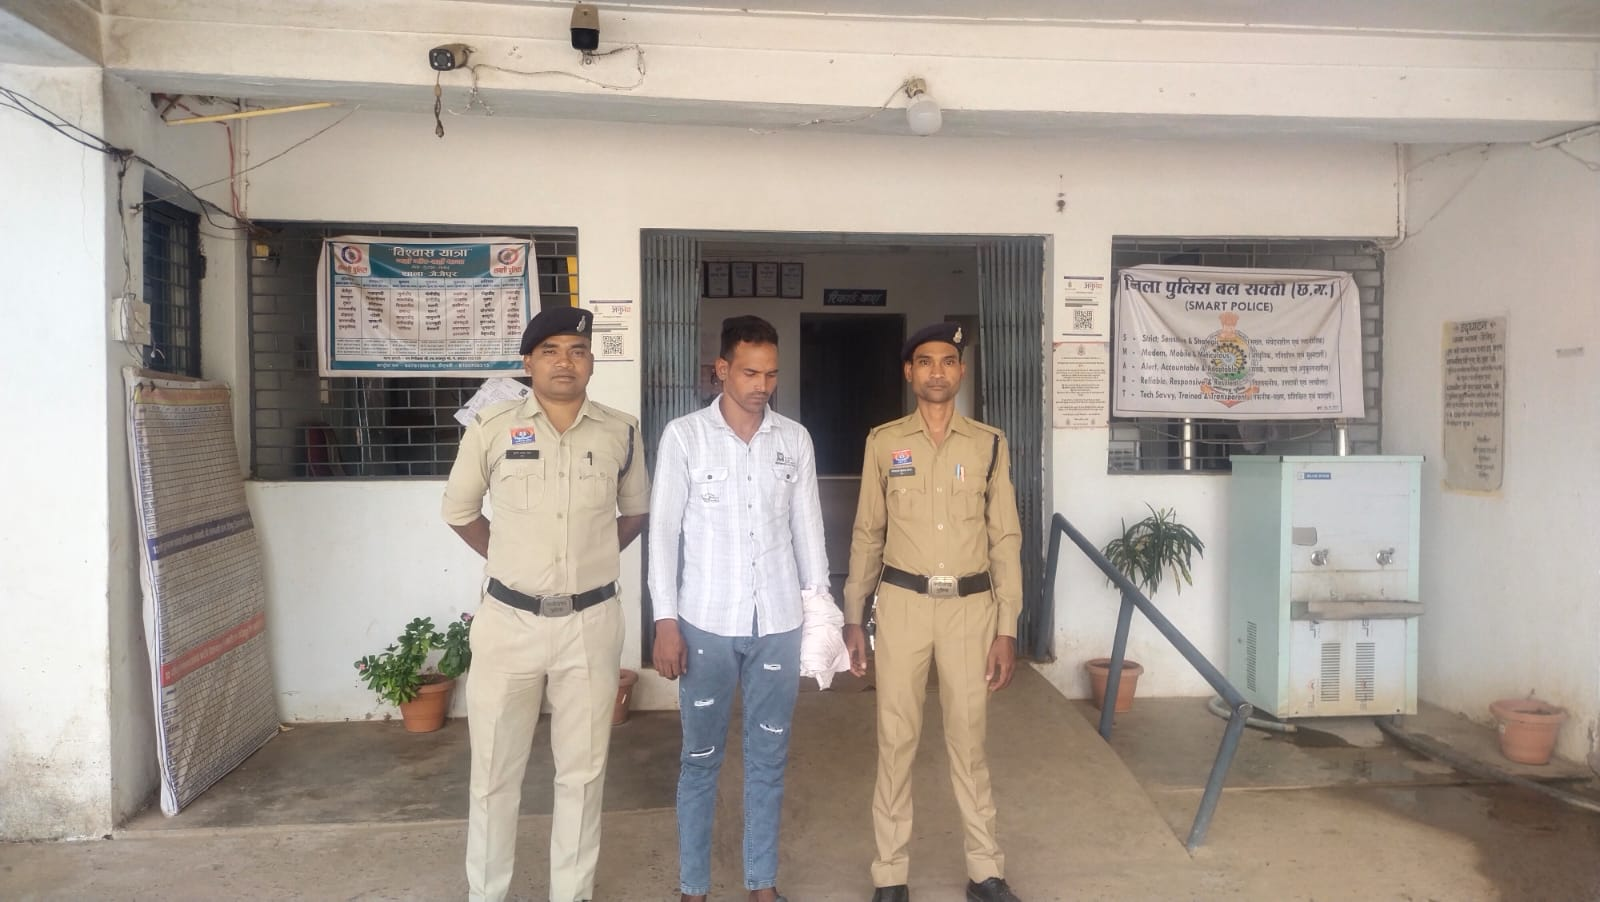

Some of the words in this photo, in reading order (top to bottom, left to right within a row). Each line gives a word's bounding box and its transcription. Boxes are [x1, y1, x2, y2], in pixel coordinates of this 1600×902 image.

[1166, 277, 1211, 299] पुलिस
[1216, 282, 1240, 295] बल
[1185, 301, 1228, 311] (SMART
[1230, 301, 1274, 312] POLICE)
[1160, 363, 1200, 372] Accountable
[1169, 377, 1205, 387] Responsive
[1140, 390, 1154, 399] Tech
[1179, 391, 1202, 400] Trained
